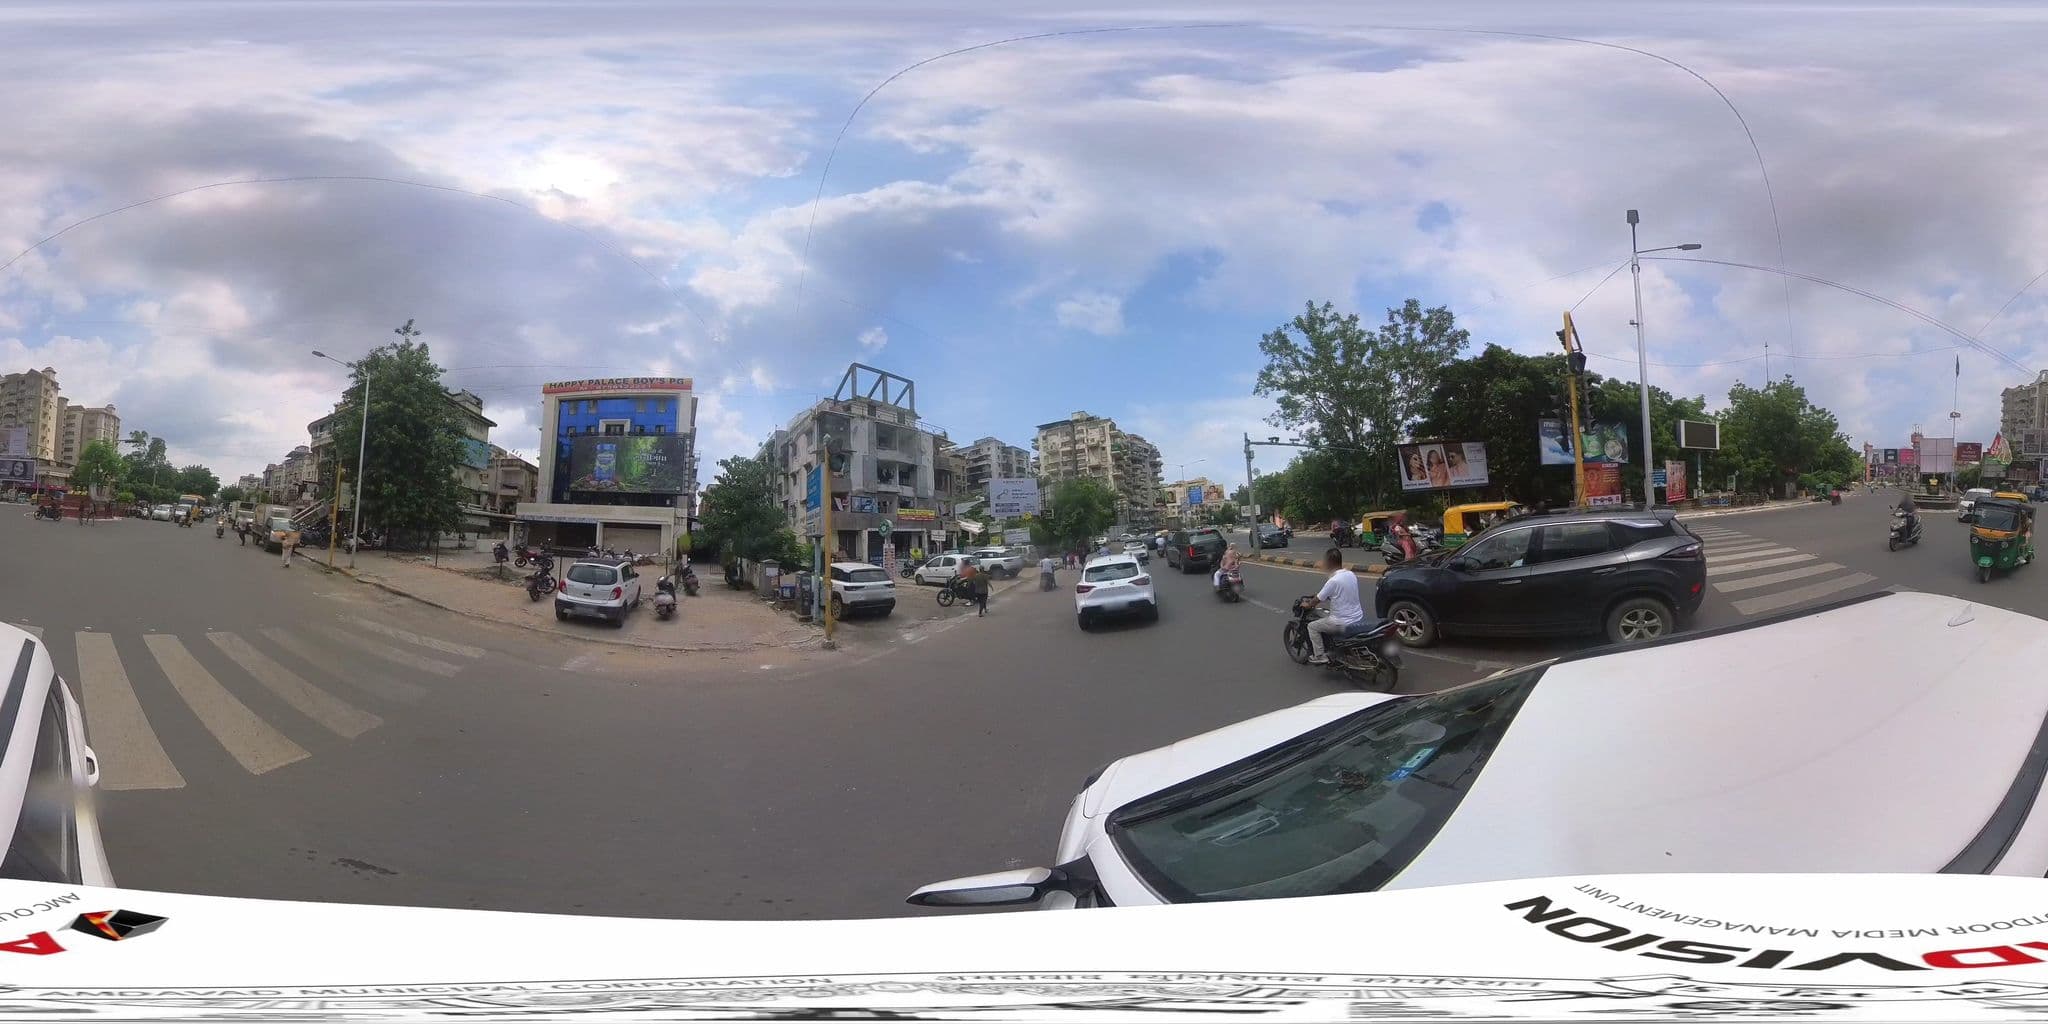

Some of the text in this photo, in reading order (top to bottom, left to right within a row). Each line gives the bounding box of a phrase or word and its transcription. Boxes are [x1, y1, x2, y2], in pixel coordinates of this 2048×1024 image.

[549, 380, 585, 389] HAPPY
[588, 377, 630, 386] PALACE
[632, 377, 665, 385] BOY'S
[669, 377, 685, 385] PG
